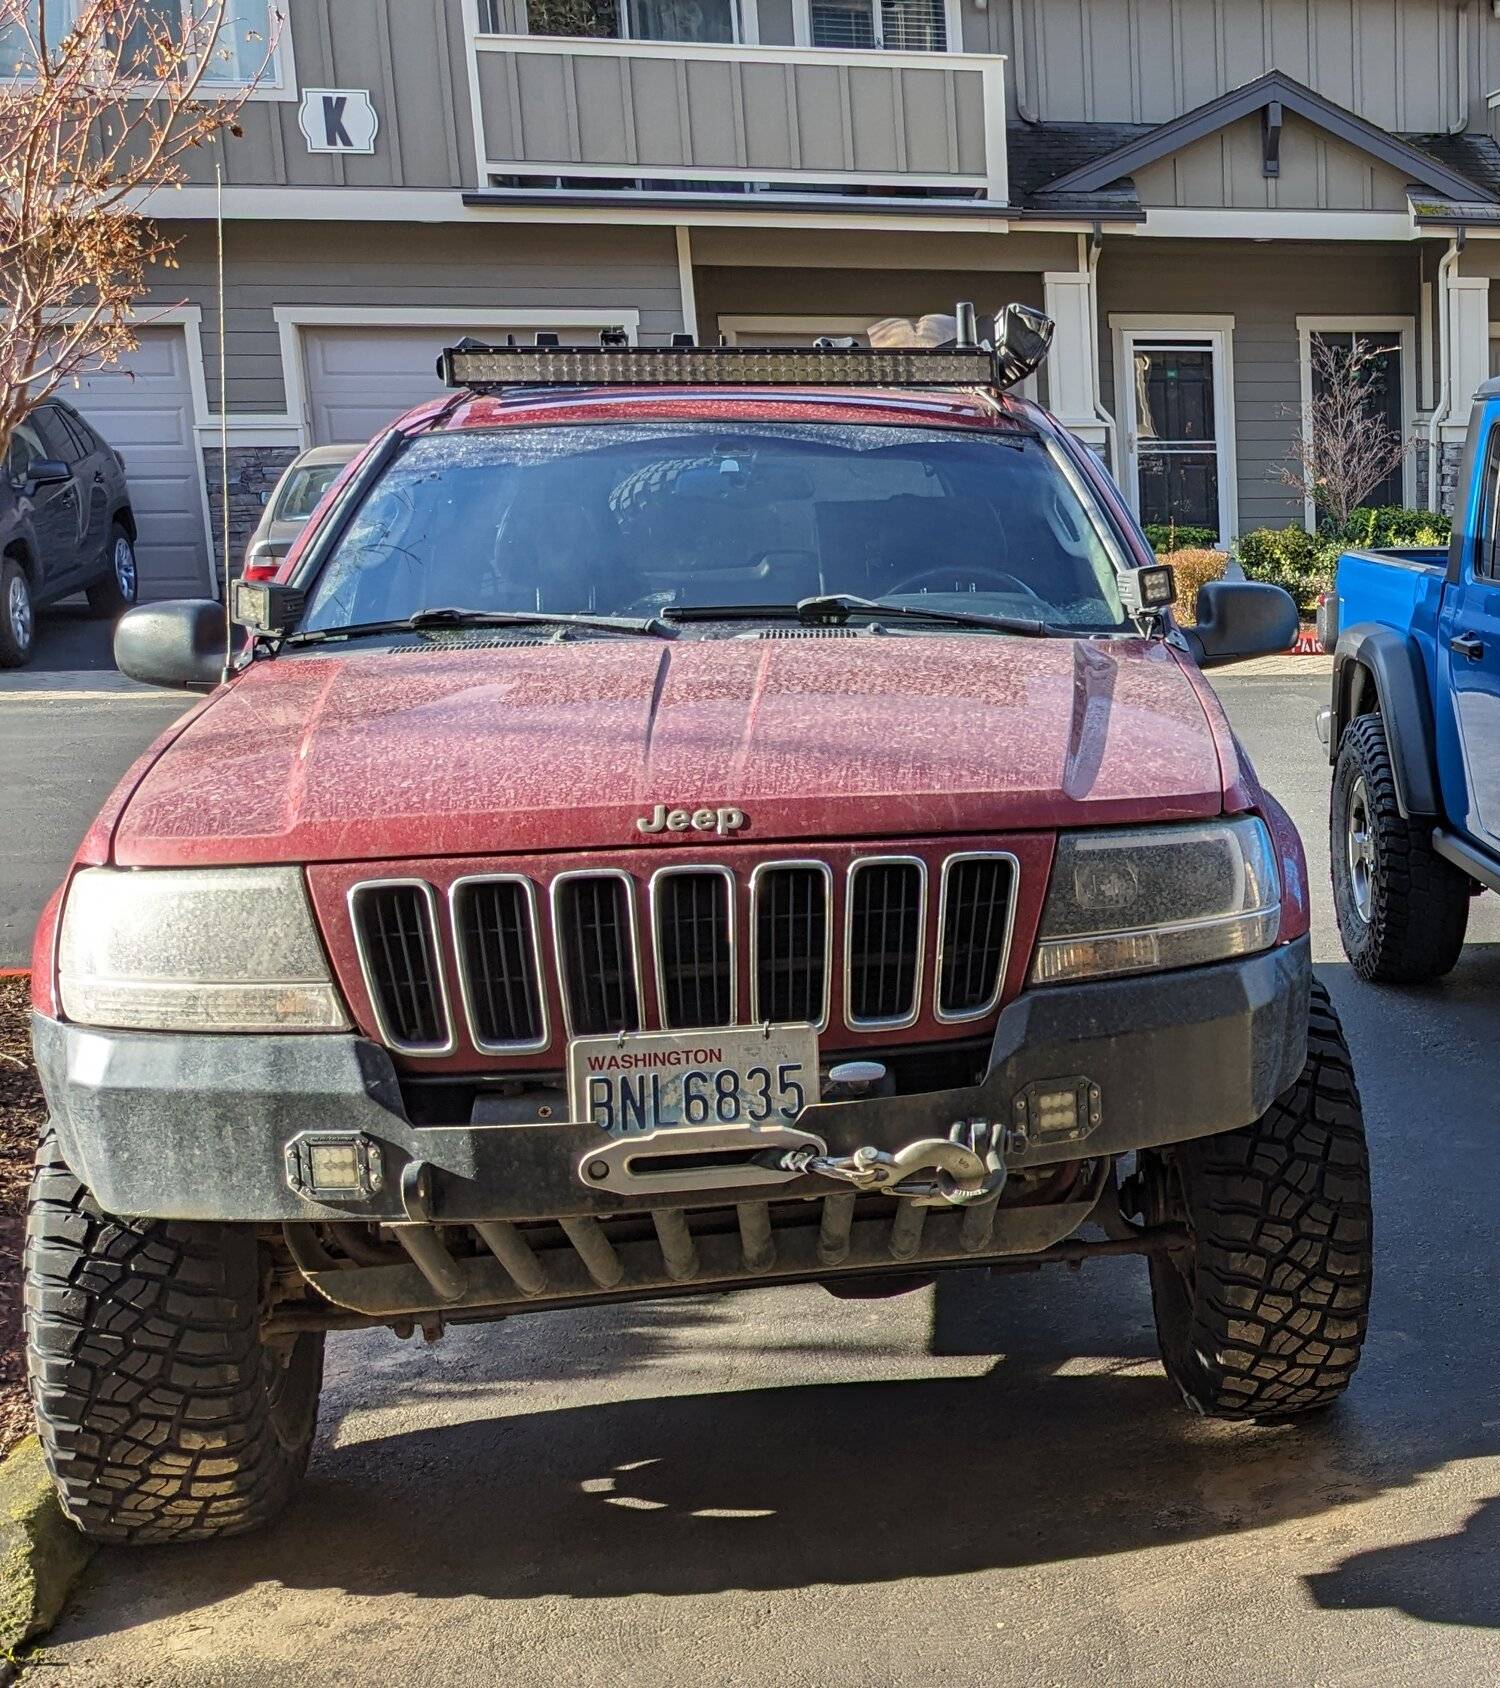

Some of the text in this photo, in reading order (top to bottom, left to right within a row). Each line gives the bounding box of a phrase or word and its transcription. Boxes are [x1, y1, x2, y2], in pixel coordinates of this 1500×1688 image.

[322, 96, 353, 146] K
[636, 804, 744, 836] Jeep
[588, 1049, 722, 1070] WASHINGTON
[587, 1064, 805, 1131] BNL6835
